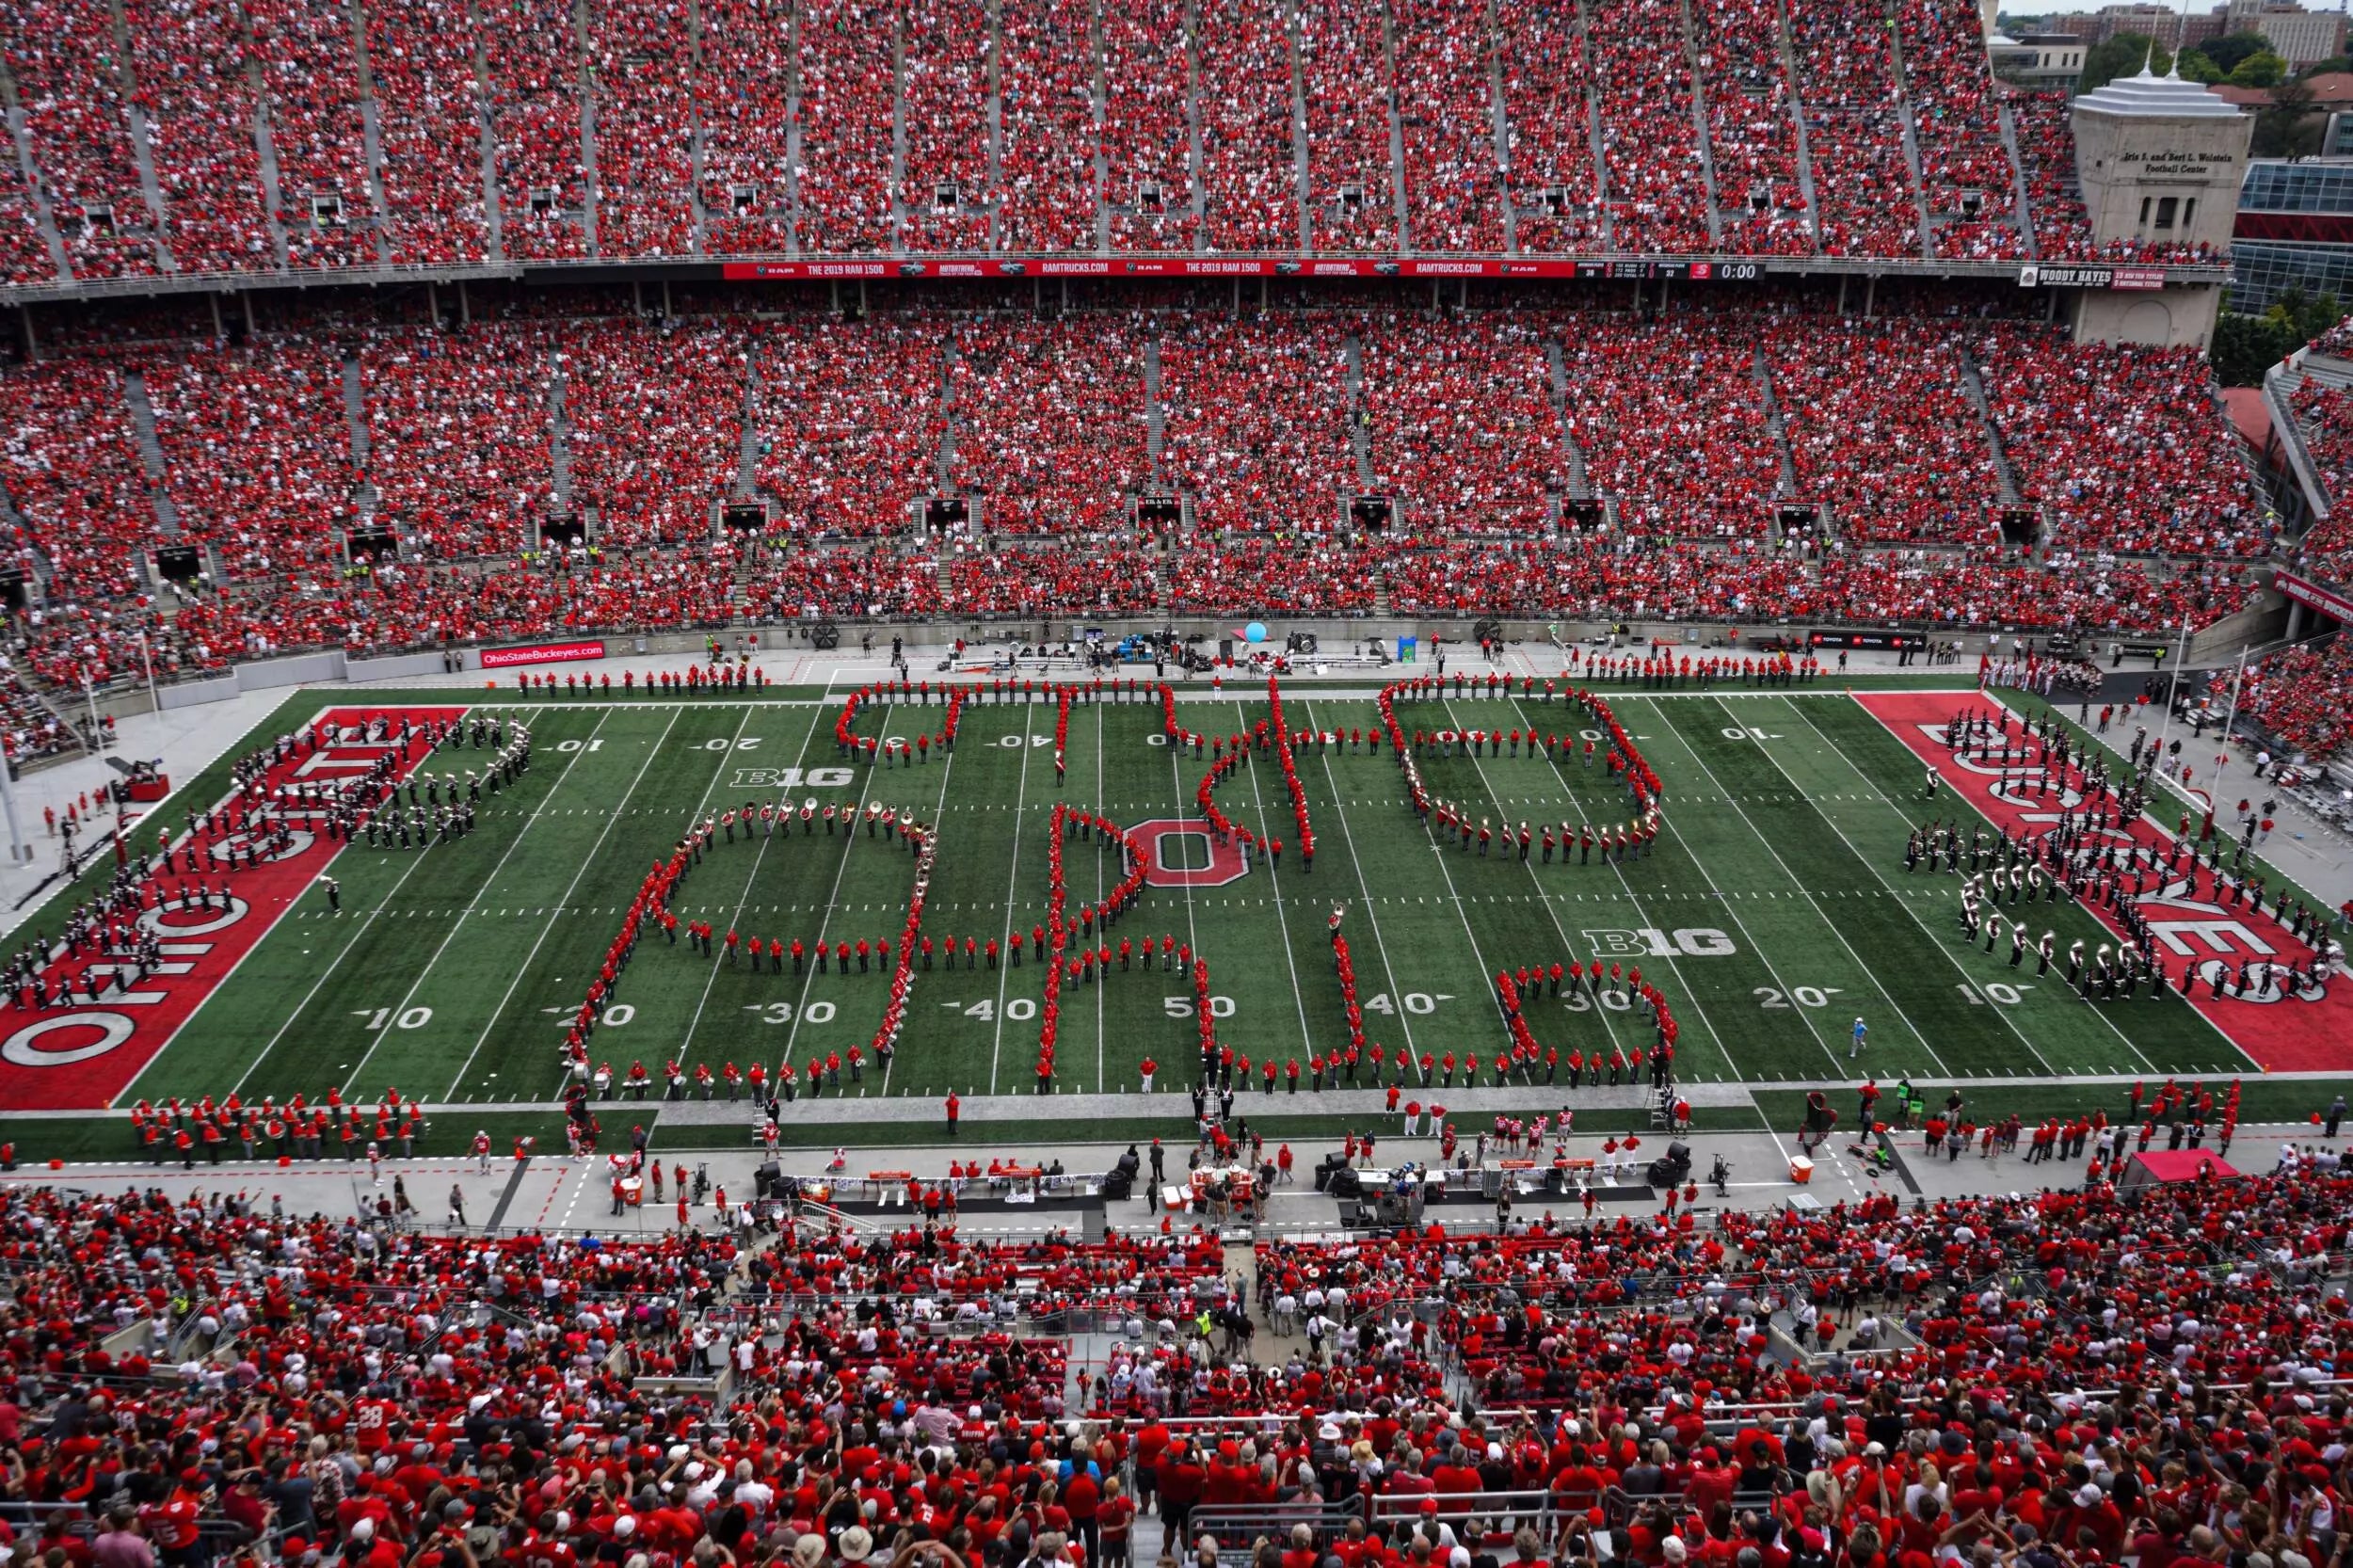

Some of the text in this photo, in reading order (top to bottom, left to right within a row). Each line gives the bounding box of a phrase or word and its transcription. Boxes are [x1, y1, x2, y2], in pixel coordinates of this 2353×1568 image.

[2150, 152, 2166, 161] and
[2168, 152, 2185, 162] Bert
[2145, 165, 2207, 173] Football Center
[808, 264, 885, 275] THE 2019 RAM 1500
[1042, 264, 1108, 273] RAMTRUCKS.COM
[1186, 263, 1260, 272] THE 2019 RAM 1500
[1417, 264, 1482, 273] RAMTRUCKS.COM
[1721, 264, 1755, 279] 0:00
[2040, 269, 2112, 282] WOODY HAYES
[484, 647, 603, 664] OhioStateBuckeyes.com
[1, 895, 250, 1066] OHIO
[1364, 993, 1435, 1015] 40
[1561, 990, 1631, 1012] 30
[1753, 986, 1828, 1008] 20
[1955, 984, 2022, 1005] 10
[763, 1001, 836, 1024] 30
[964, 999, 1036, 1021] 40
[1163, 996, 1236, 1017] 50
[364, 1007, 433, 1030] 10
[358, 1405, 384, 1429] 28
